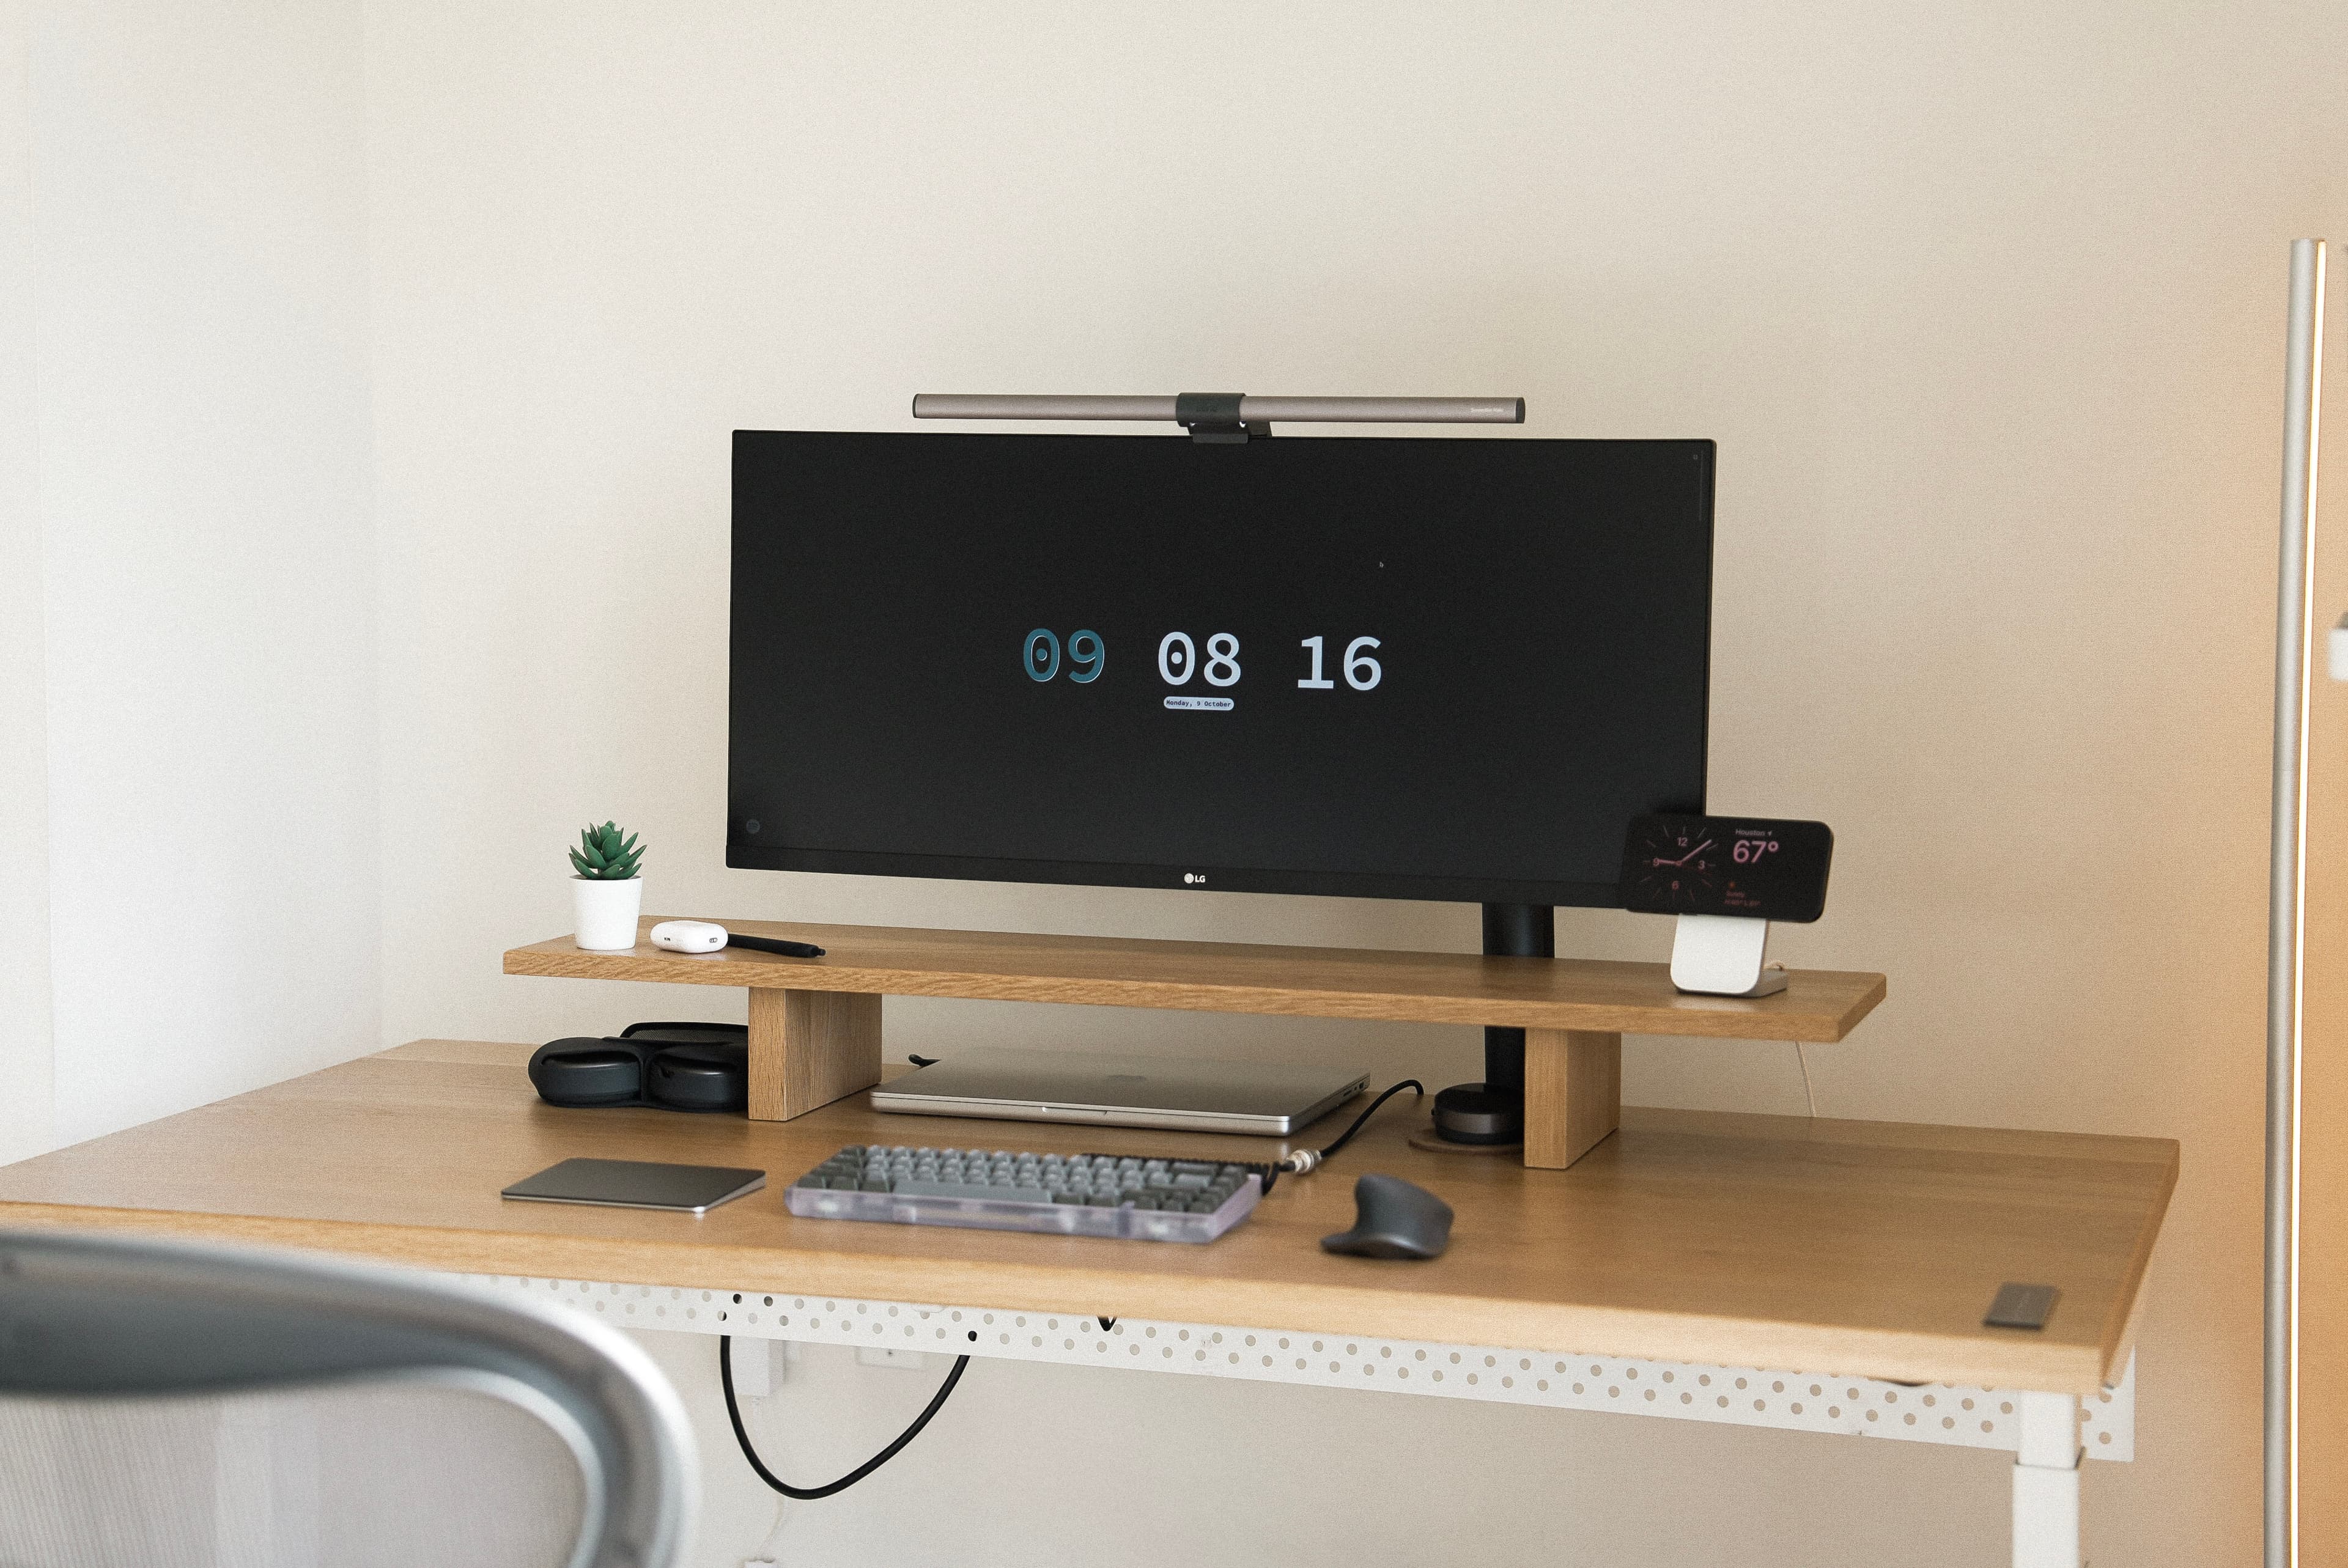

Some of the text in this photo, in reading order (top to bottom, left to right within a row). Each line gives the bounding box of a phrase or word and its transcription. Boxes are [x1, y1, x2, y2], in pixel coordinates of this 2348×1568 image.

[1023, 628, 1382, 691] 09 08 16
[1677, 837, 1688, 847] 12
[1733, 839, 1779, 864] 67°
[1697, 859, 1705, 869] 3
[1672, 880, 1679, 890] 6
